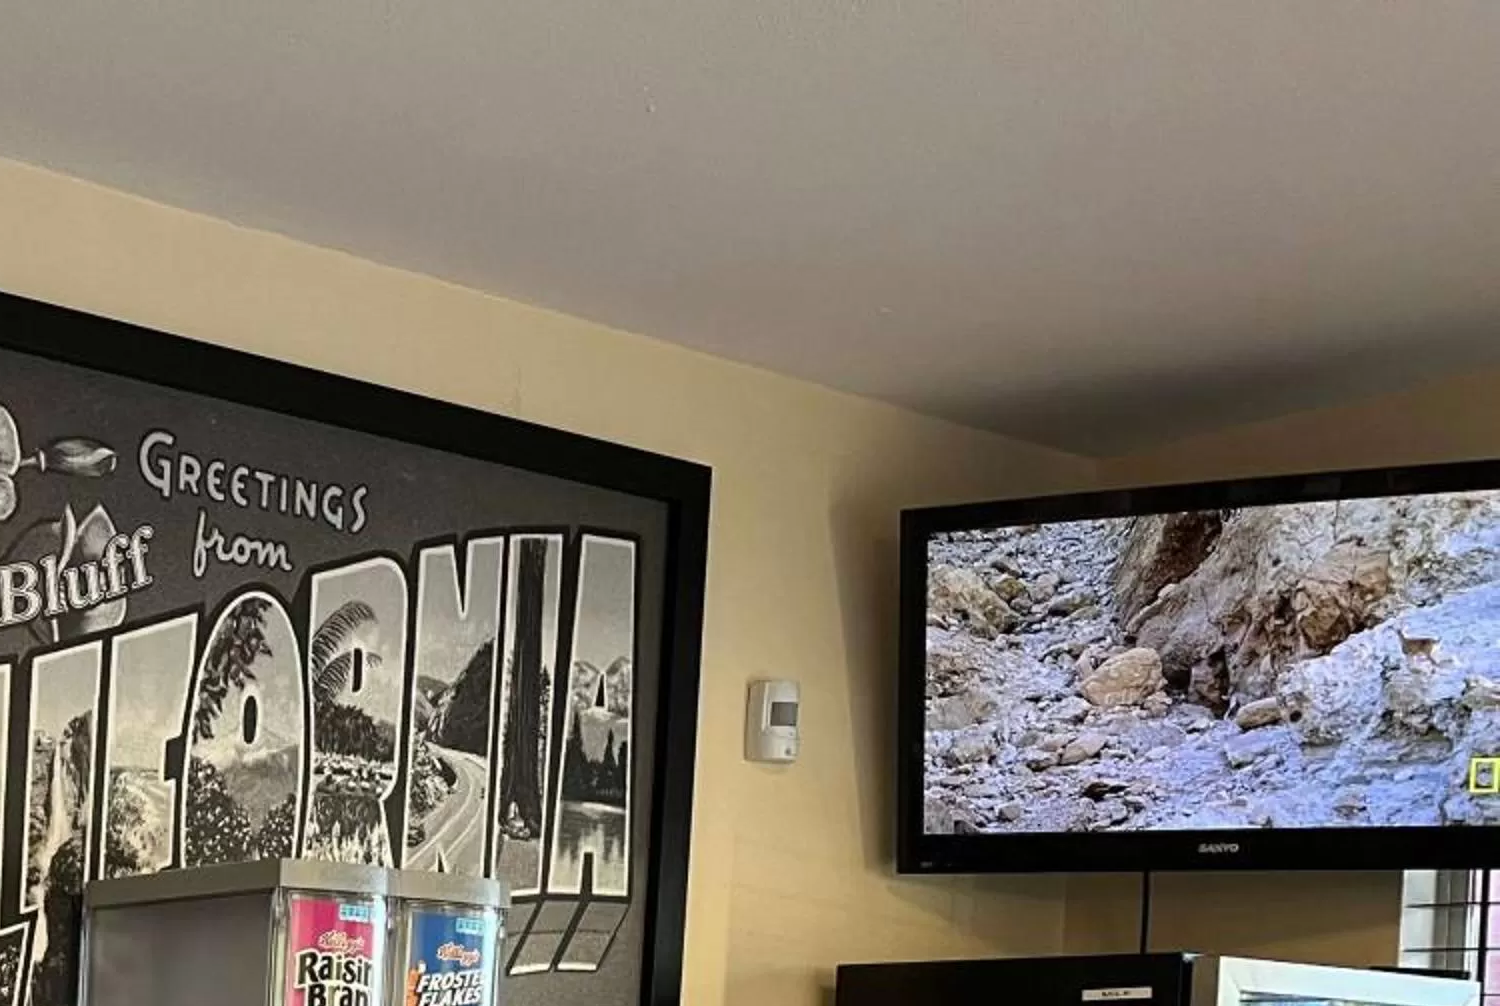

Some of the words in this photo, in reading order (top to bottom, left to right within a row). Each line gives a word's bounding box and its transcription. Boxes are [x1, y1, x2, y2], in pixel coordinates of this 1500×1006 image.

[137, 429, 368, 534] GREETINGS
[193, 509, 293, 577] from
[415, 970, 484, 994] FROSTE
